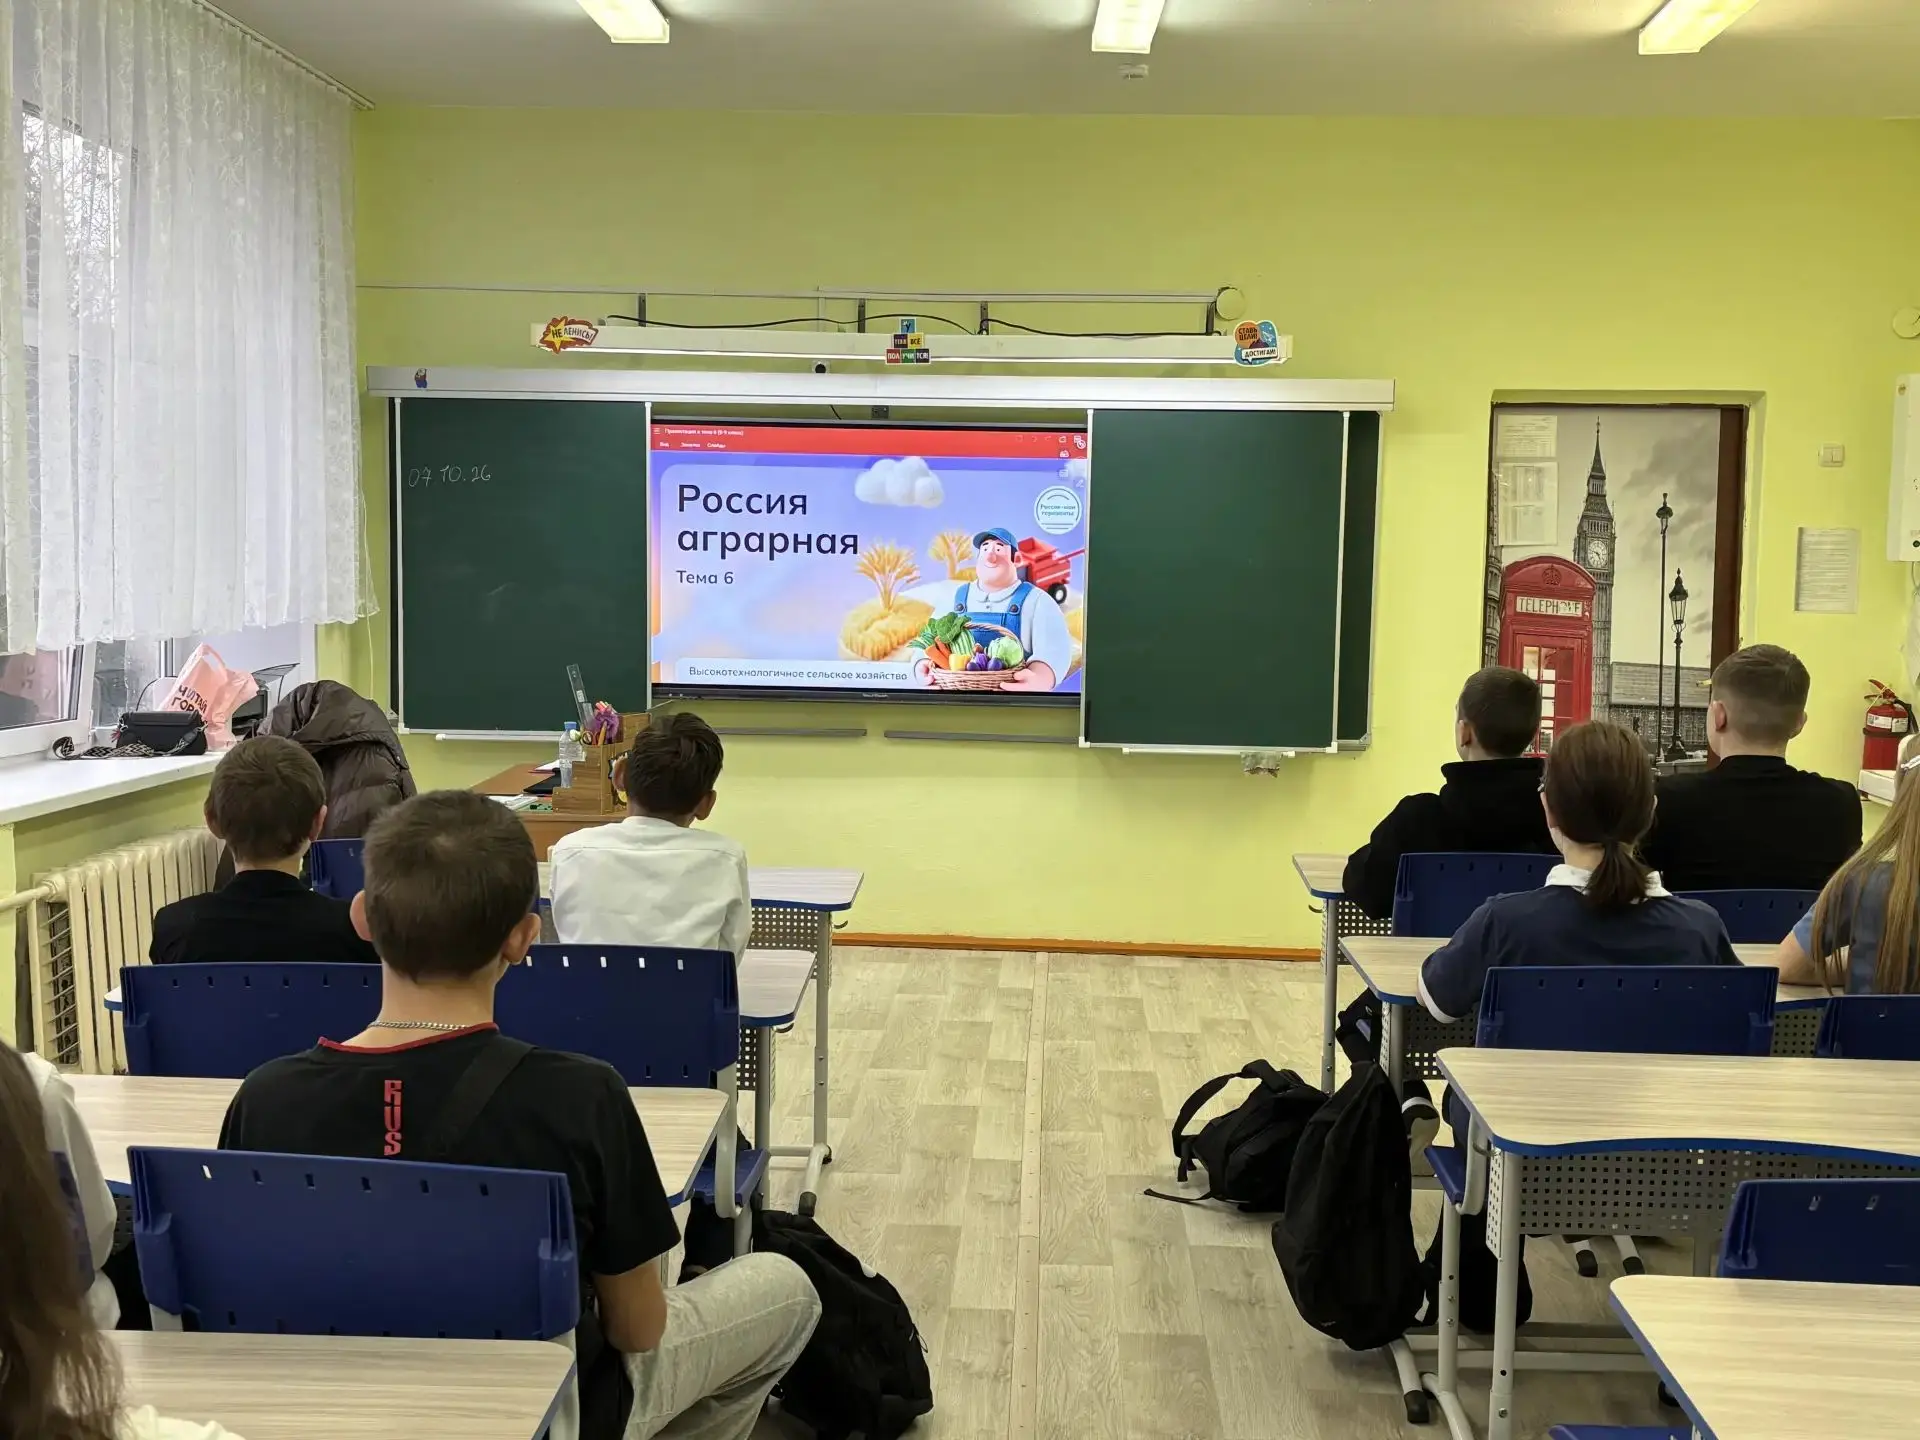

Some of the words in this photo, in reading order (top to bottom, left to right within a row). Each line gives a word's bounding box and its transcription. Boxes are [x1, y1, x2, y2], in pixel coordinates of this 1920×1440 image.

[551, 328, 563, 339] НЕ
[563, 326, 593, 341] ЛЕНИСЬ!
[678, 484, 807, 515] Россия
[677, 530, 858, 561] аграрная
[676, 569, 718, 584] Тема
[724, 571, 734, 585] 6
[689, 666, 805, 679] Высокотехнологичное
[806, 669, 853, 680] сельское
[855, 671, 908, 681] хозяйство
[178, 684, 208, 713] ЧИТАЙ
[383, 1079, 402, 1156] RUS
